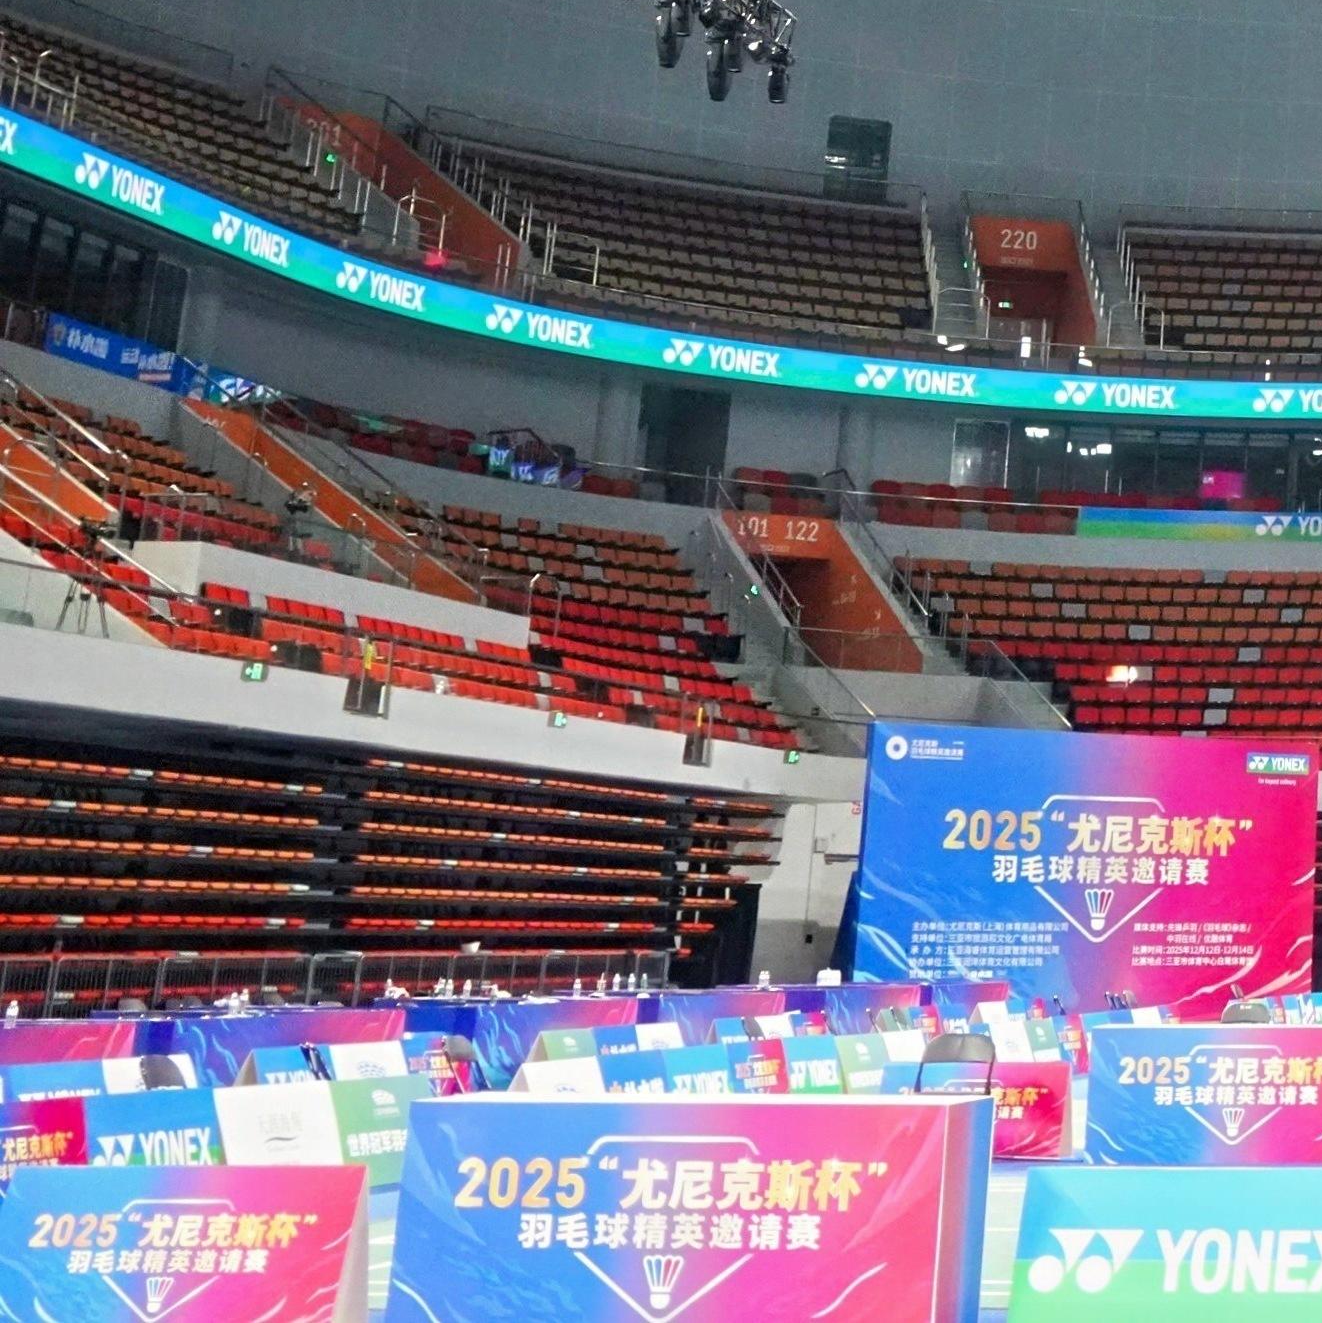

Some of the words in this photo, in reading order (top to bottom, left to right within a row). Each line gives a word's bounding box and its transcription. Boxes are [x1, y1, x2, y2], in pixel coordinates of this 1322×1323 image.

[111, 164, 165, 216] YONEX
[243, 221, 291, 269] YONEX
[1000, 229, 1037, 250] 220
[370, 270, 426, 313] YONEX
[526, 310, 594, 349] YONEX
[708, 344, 779, 377] YONEX
[903, 367, 977, 397] YONEX
[1102, 383, 1176, 410] YONEX
[785, 521, 819, 541] 122
[1271, 757, 1306, 772] YONEX
[992, 855, 1209, 886] 羽毛球精英邀请赛
[1154, 1085, 1319, 1107] 羽毛球精英邀请赛
[139, 1127, 210, 1166] YONEX
[517, 1213, 822, 1251] 羽毛球精英邀请赛
[67, 1249, 269, 1275] 羽毛球精英邀请赛
